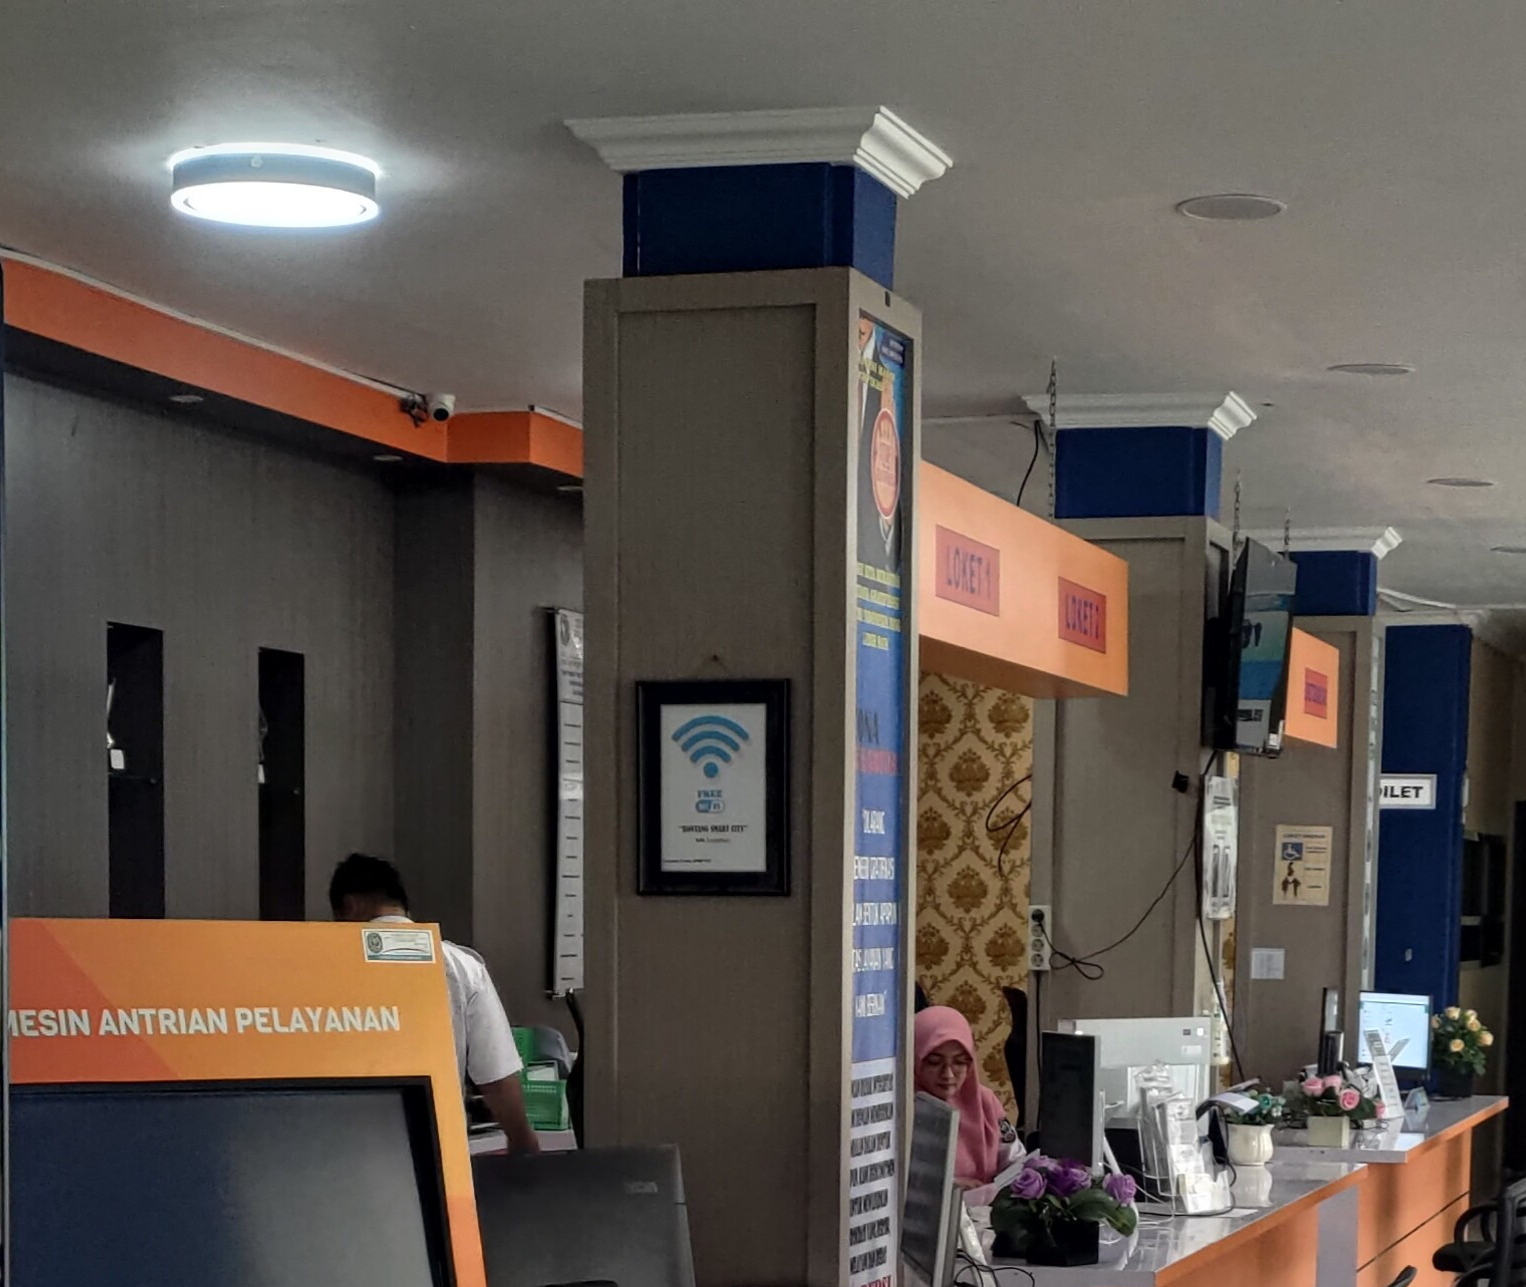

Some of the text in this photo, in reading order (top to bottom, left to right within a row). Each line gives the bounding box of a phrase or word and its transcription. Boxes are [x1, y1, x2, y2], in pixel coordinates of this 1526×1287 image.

[946, 546, 982, 597] LOKET
[1379, 785, 1423, 798] ILET
[99, 1007, 228, 1035] ANTRIAN
[235, 1006, 400, 1034] PELAYANAN
